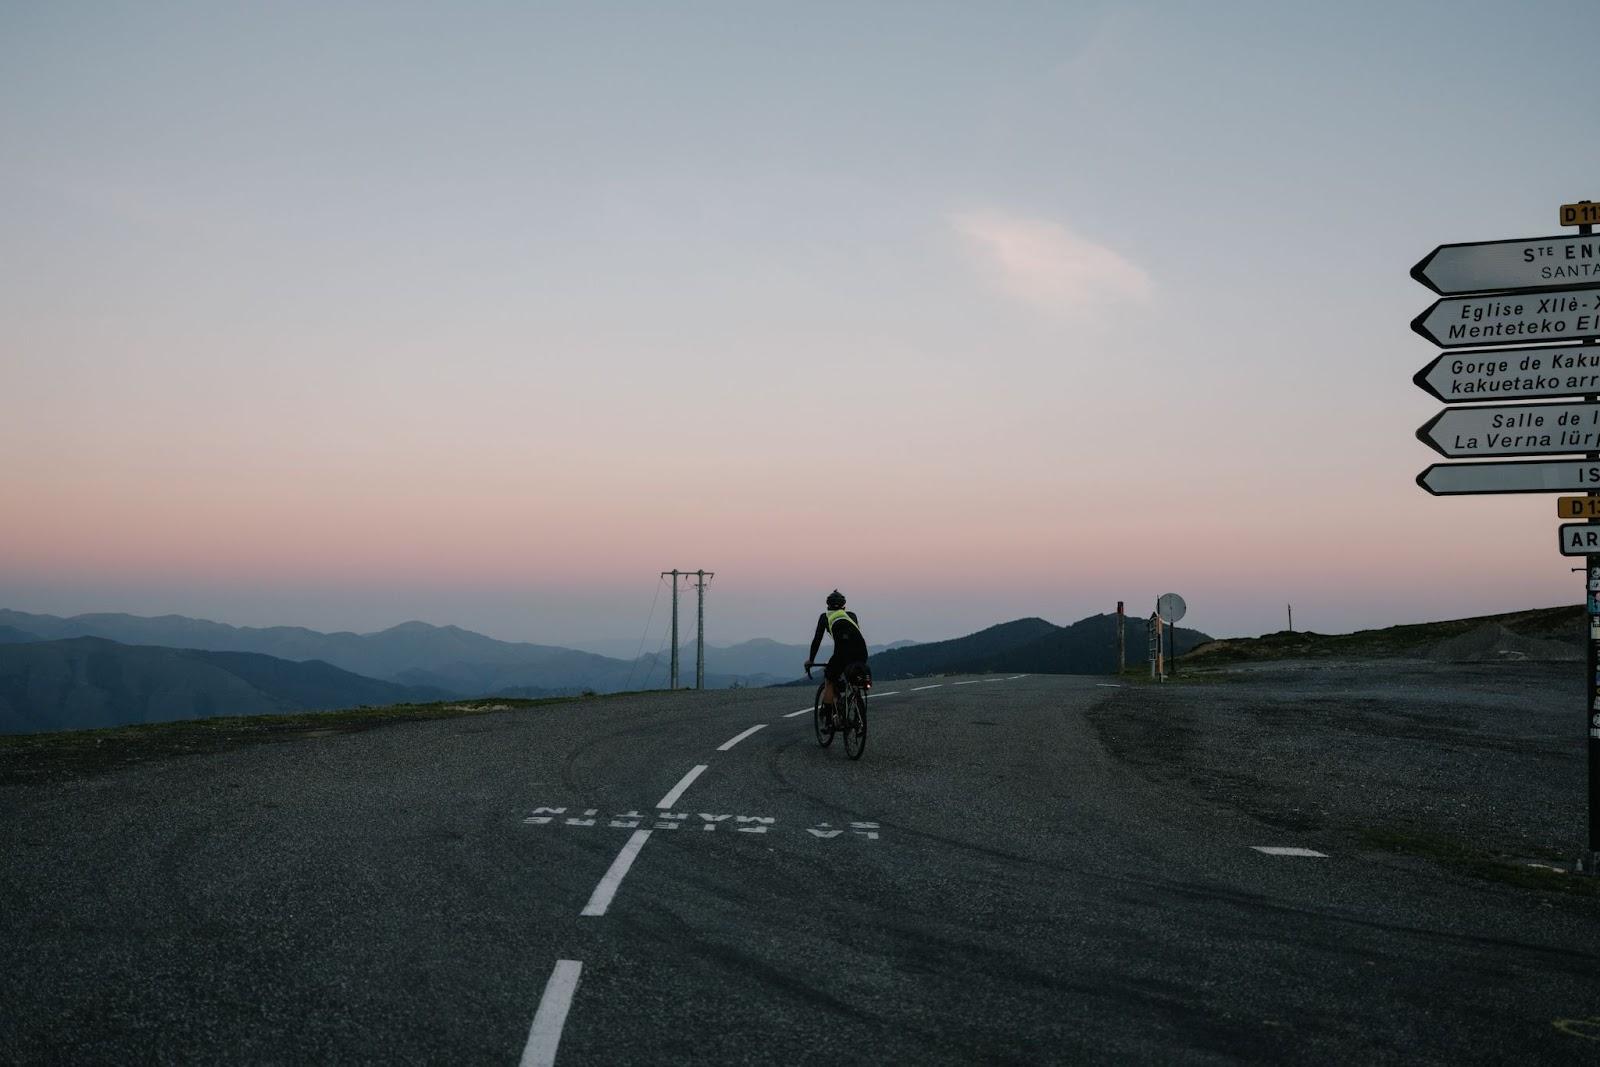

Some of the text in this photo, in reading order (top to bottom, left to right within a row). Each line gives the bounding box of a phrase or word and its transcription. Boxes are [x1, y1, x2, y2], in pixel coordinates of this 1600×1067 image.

[1565, 205, 1600, 222] D 11
[1565, 244, 1600, 260] EN
[1461, 303, 1524, 322] Eglise
[1449, 318, 1566, 339] Menteteko
[1452, 353, 1600, 376] Gorge de Kaku
[1451, 374, 1600, 394] kakuetako arr
[1492, 412, 1544, 429] Salle
[1558, 411, 1580, 426] de
[1454, 435, 1478, 449] La
[1487, 433, 1551, 448] Verna
[1579, 467, 1600, 483] IS
[1572, 499, 1600, 515] D 1
[1571, 532, 1598, 547] AR
[531, 806, 776, 824] MARTIN
[522, 816, 880, 840] LA PIERRE
